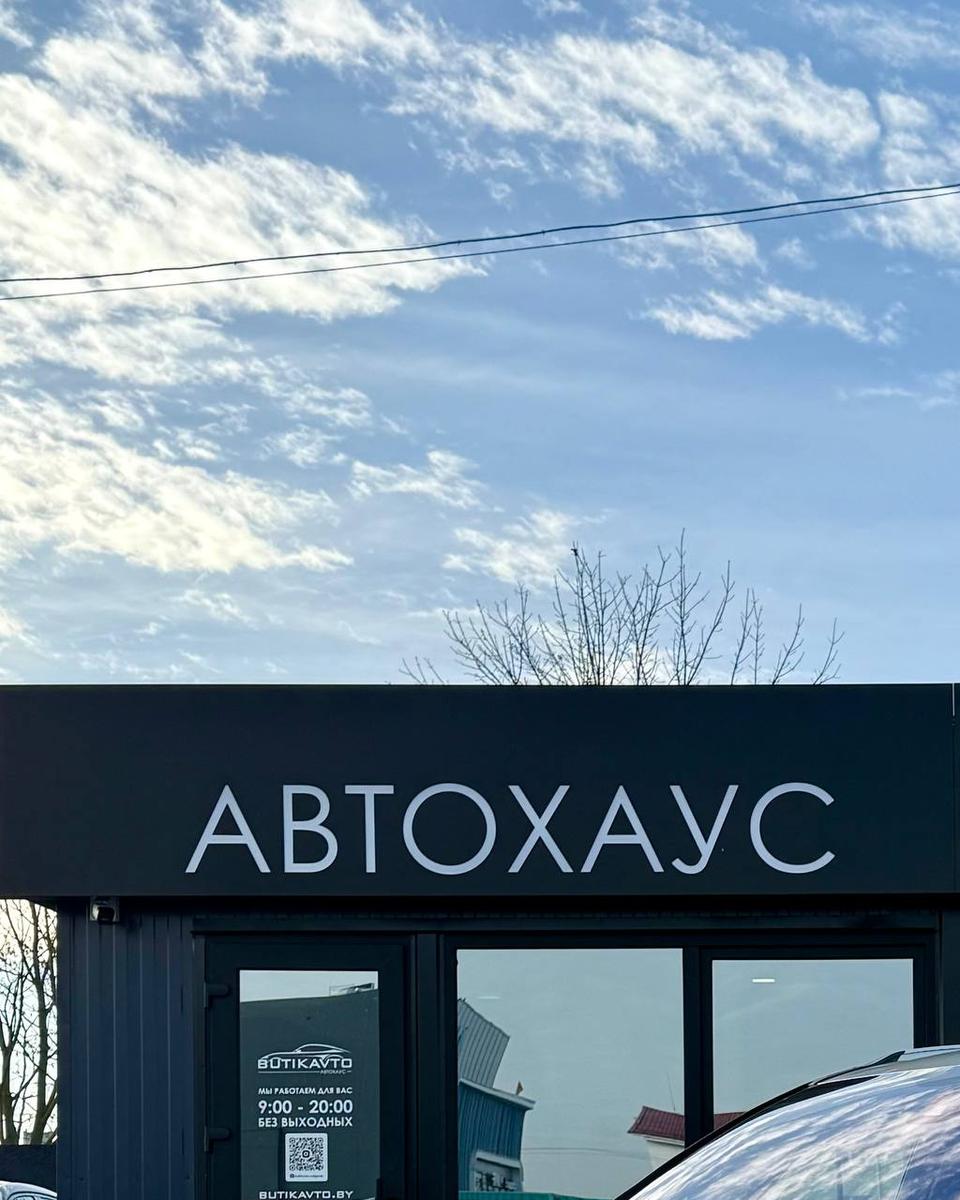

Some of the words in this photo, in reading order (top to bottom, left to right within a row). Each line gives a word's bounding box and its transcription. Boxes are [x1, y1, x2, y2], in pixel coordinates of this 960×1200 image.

[185, 782, 836, 875] АВТОХАУС
[258, 1058, 353, 1069] BUTIKAVTO
[258, 1087, 273, 1095] МЫ
[274, 1087, 316, 1095] РАБОТАЕМ
[317, 1087, 334, 1096] ДЛЯ
[258, 1100, 292, 1114] 9:00
[309, 1100, 353, 1114] 20:00
[258, 1117, 278, 1128] БЕЗ
[281, 1117, 353, 1128] ВЫХОДНЫХ
[259, 1191, 353, 1199] BUTIKAVTO.BY
